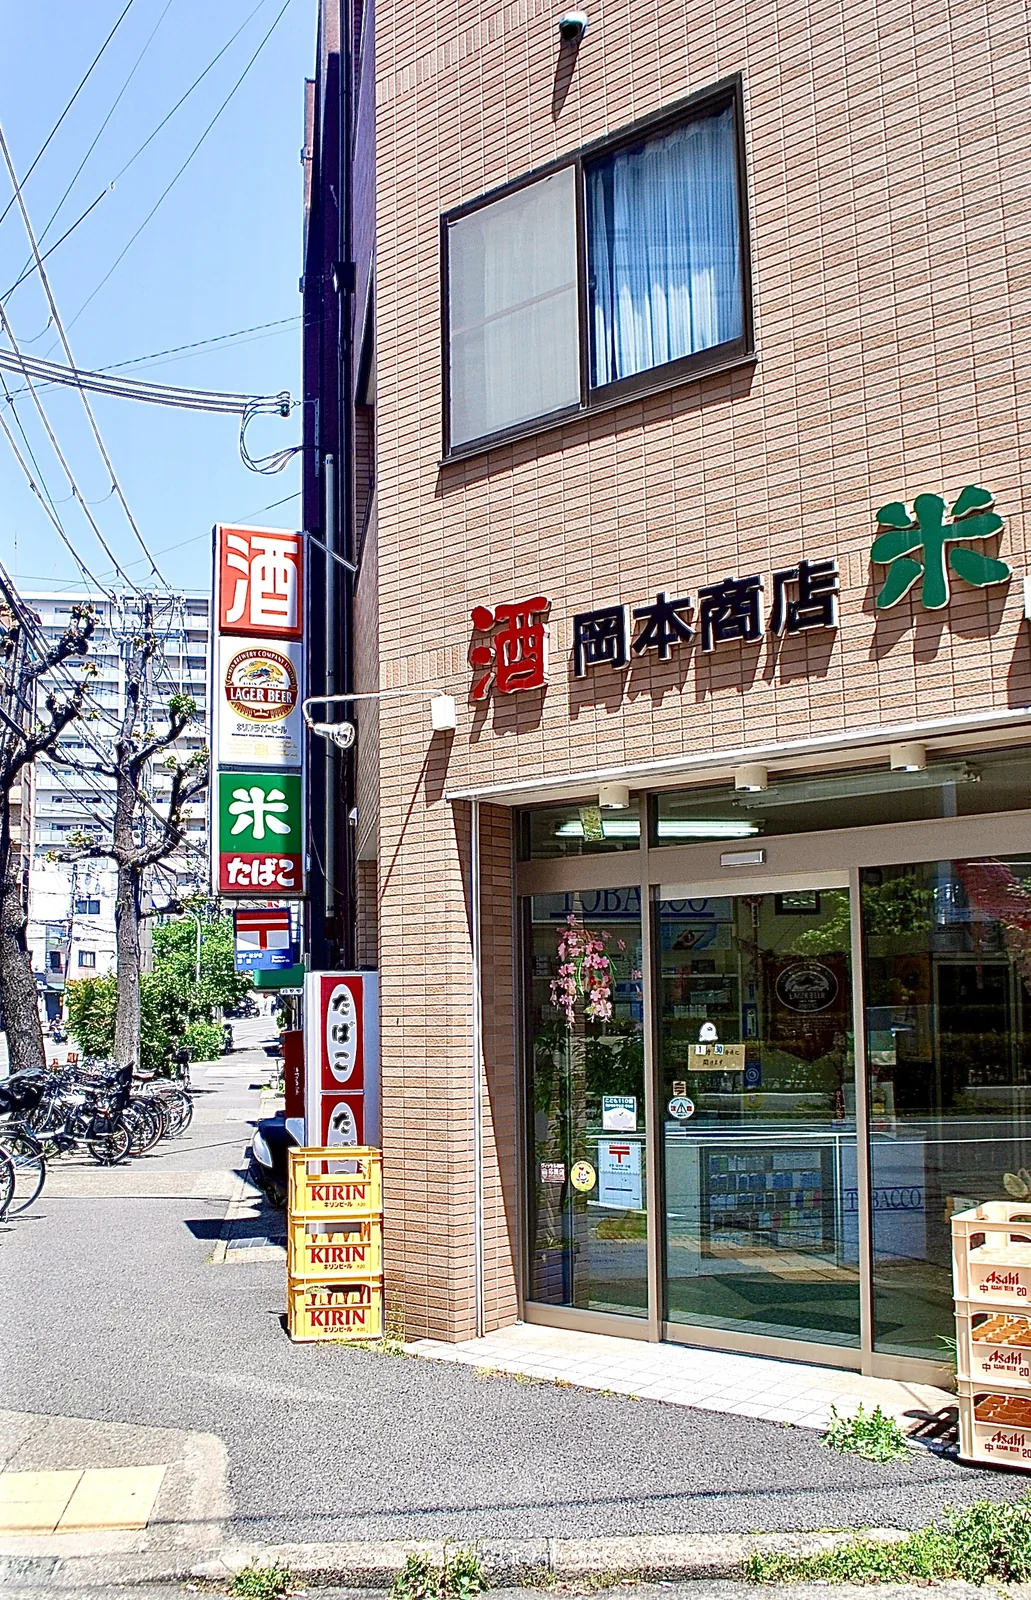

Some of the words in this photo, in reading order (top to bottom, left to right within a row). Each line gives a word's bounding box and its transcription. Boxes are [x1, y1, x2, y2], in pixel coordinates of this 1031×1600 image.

[226, 533, 298, 628] 酒
[470, 596, 552, 700] 酒
[572, 558, 840, 679] 岡本商店
[870, 485, 1013, 611] 米
[257, 650, 284, 665] COMPANY
[230, 688, 265, 701] LAGER
[267, 689, 292, 703] BEER
[228, 785, 291, 840] 米
[226, 856, 296, 888] たばこ
[331, 993, 356, 1072] たばこ
[311, 1185, 366, 1201] KIRIN
[846, 1188, 922, 1209] TBACCO
[310, 1246, 366, 1264] KIRIN
[985, 1270, 1019, 1286] Asahi
[979, 1284, 989, 1294] 中
[1016, 1287, 1027, 1297] 20
[310, 1309, 366, 1327] KIRIN
[988, 1349, 1022, 1366] Asahi
[982, 1362, 991, 1373] 中
[1019, 1367, 1030, 1377] 20
[991, 1430, 1025, 1447] Asahi
[984, 1442, 994, 1453] 中
